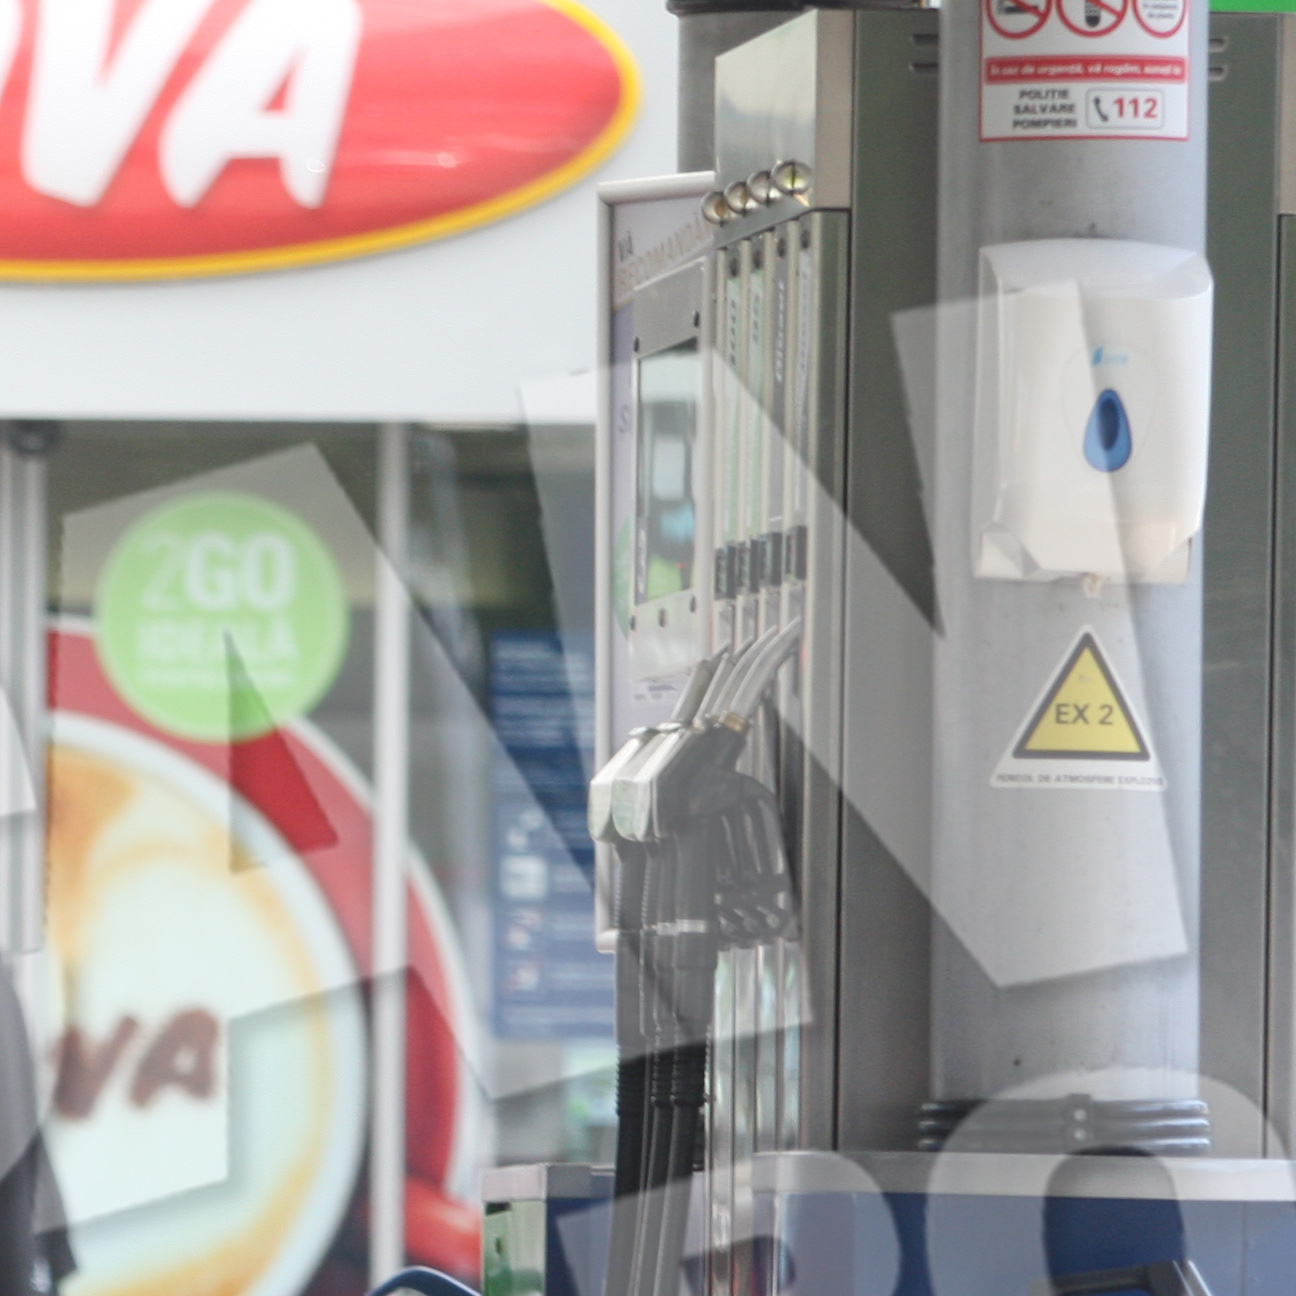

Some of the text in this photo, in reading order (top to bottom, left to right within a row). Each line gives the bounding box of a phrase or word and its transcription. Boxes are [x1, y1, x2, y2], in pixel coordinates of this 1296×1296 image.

[1013, 97, 1159, 119] SALVARE 112
[1011, 119, 1078, 130] POMPIERI
[141, 530, 298, 613] 2GO
[1055, 704, 1114, 725] EX 2
